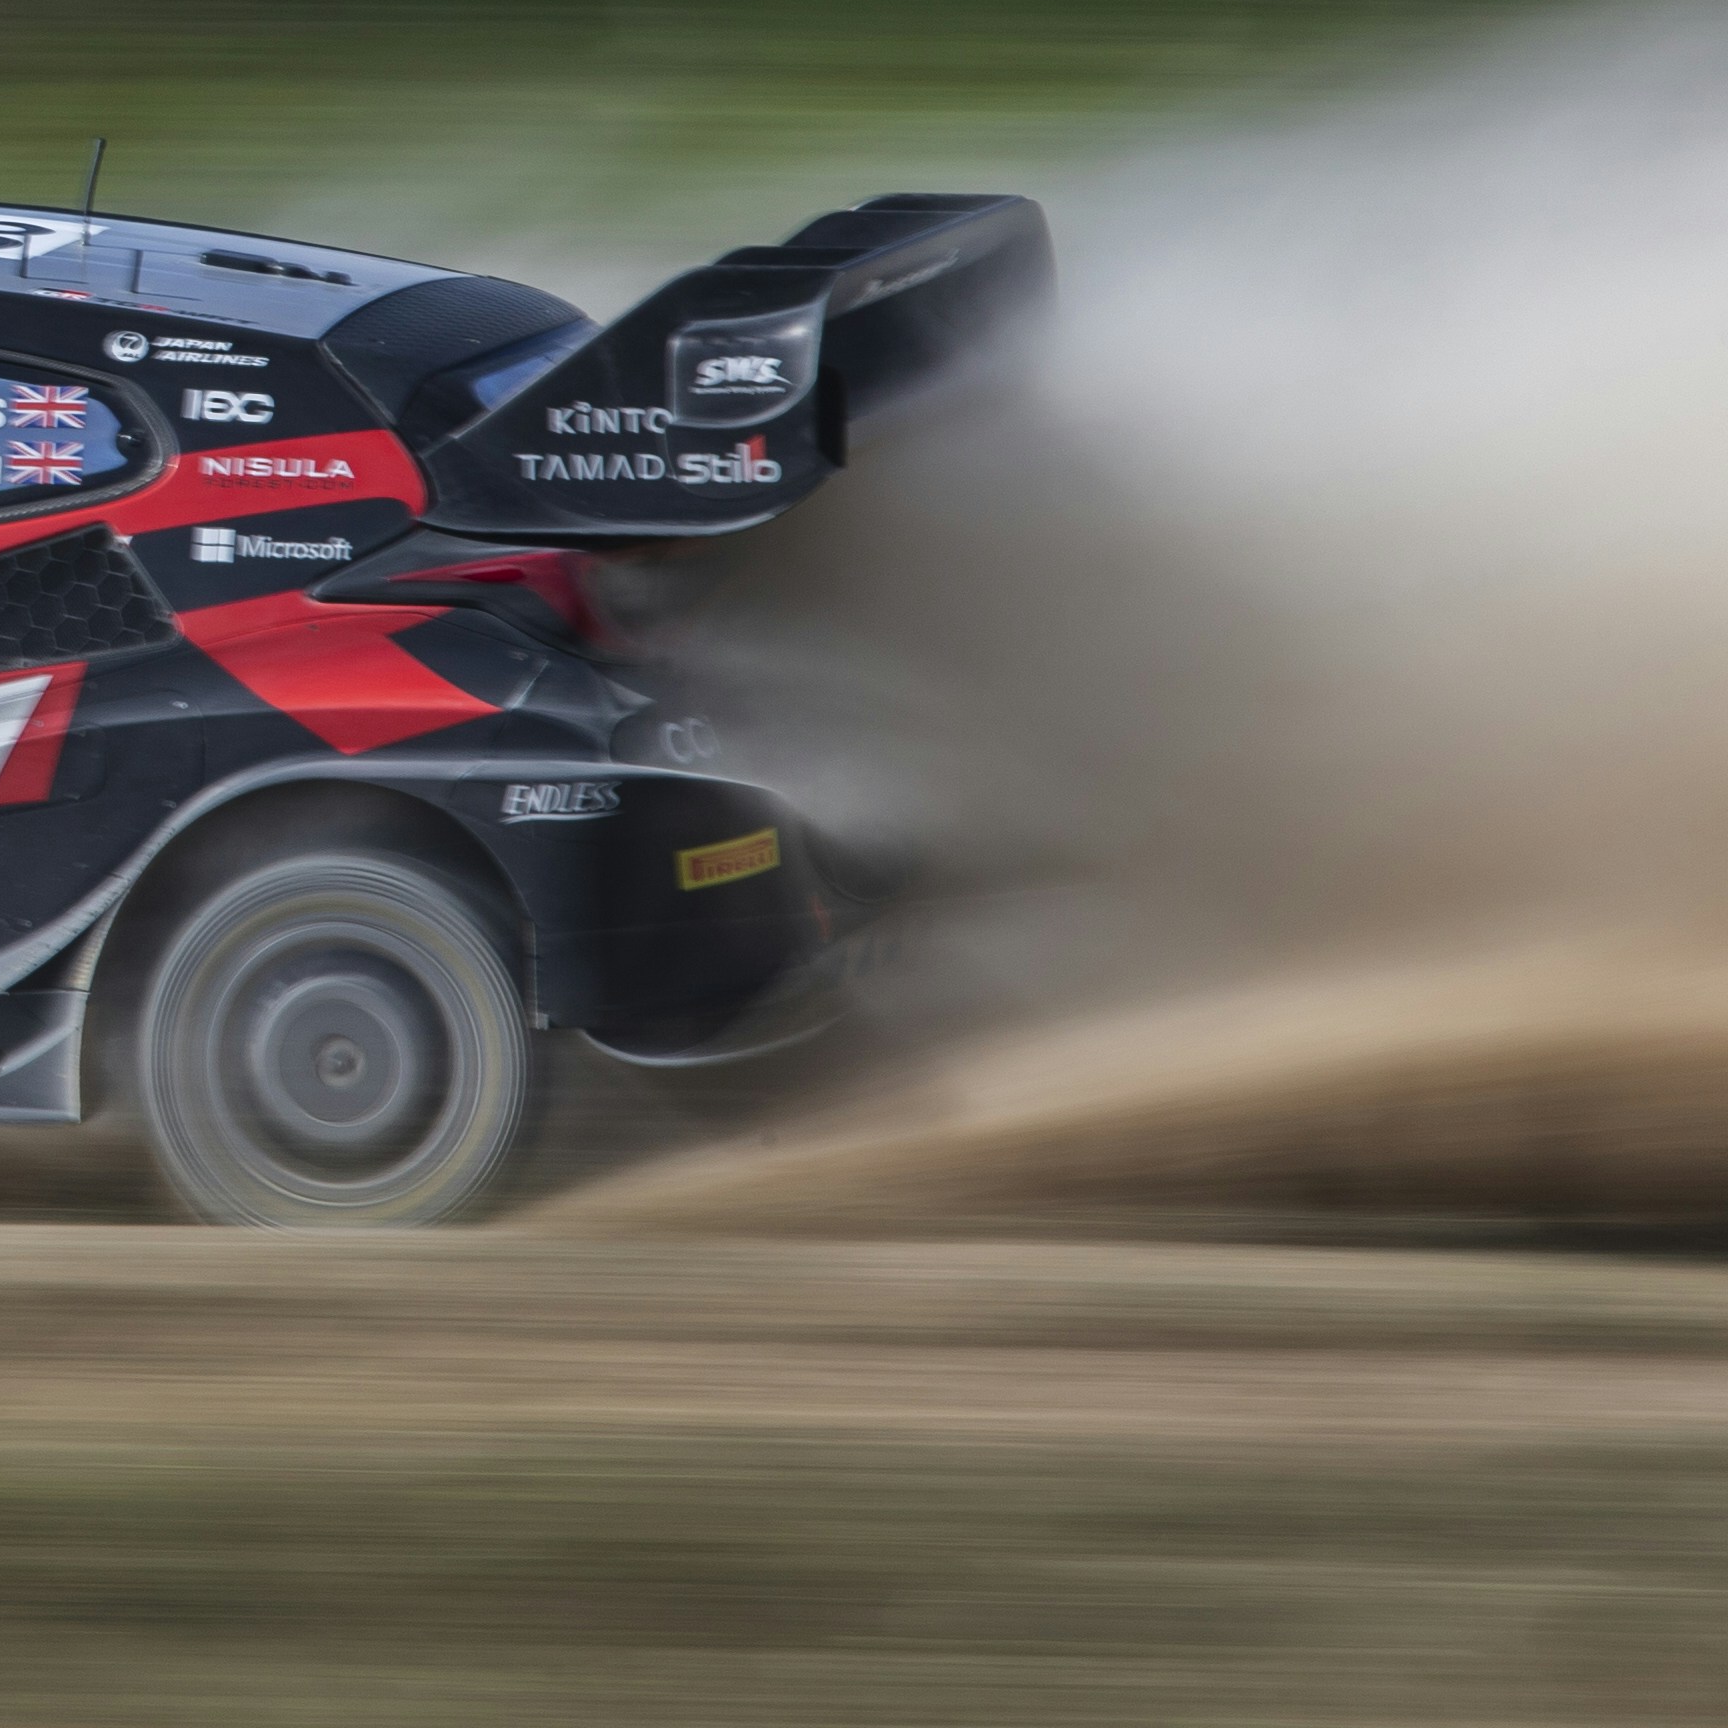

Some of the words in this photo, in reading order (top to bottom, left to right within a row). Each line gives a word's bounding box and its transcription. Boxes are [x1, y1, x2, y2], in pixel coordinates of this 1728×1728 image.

[150, 336, 234, 352] JAPAN
[150, 349, 271, 368] AIRLINES
[199, 456, 356, 480] NISULA
[513, 453, 676, 481] TAMAD
[676, 435, 783, 484] Stilo
[235, 533, 354, 561] Microsoft
[501, 780, 623, 815] ENDLESS
